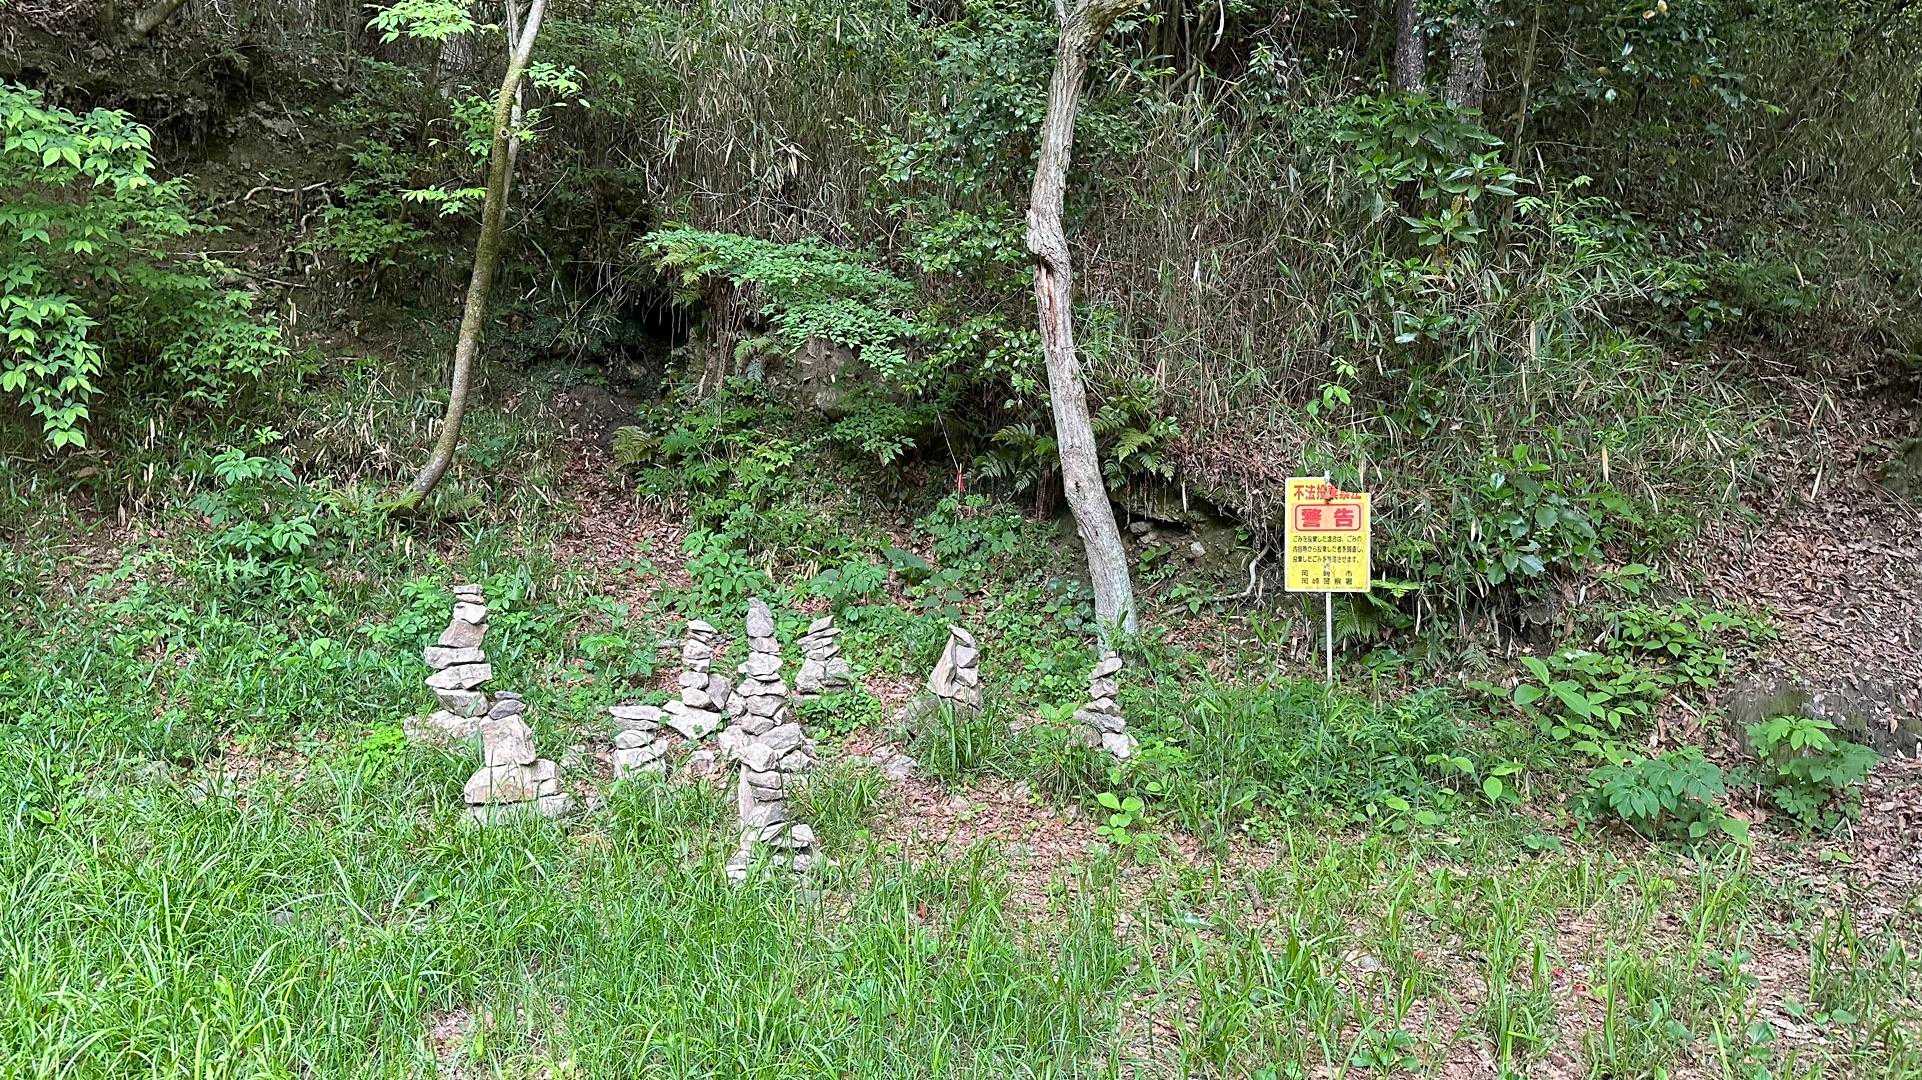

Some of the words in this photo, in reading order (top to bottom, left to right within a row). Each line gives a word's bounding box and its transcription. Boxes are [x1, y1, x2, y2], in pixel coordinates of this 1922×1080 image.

[1294, 484, 1361, 500] 不法投禁
[1302, 508, 1354, 527] 警告
